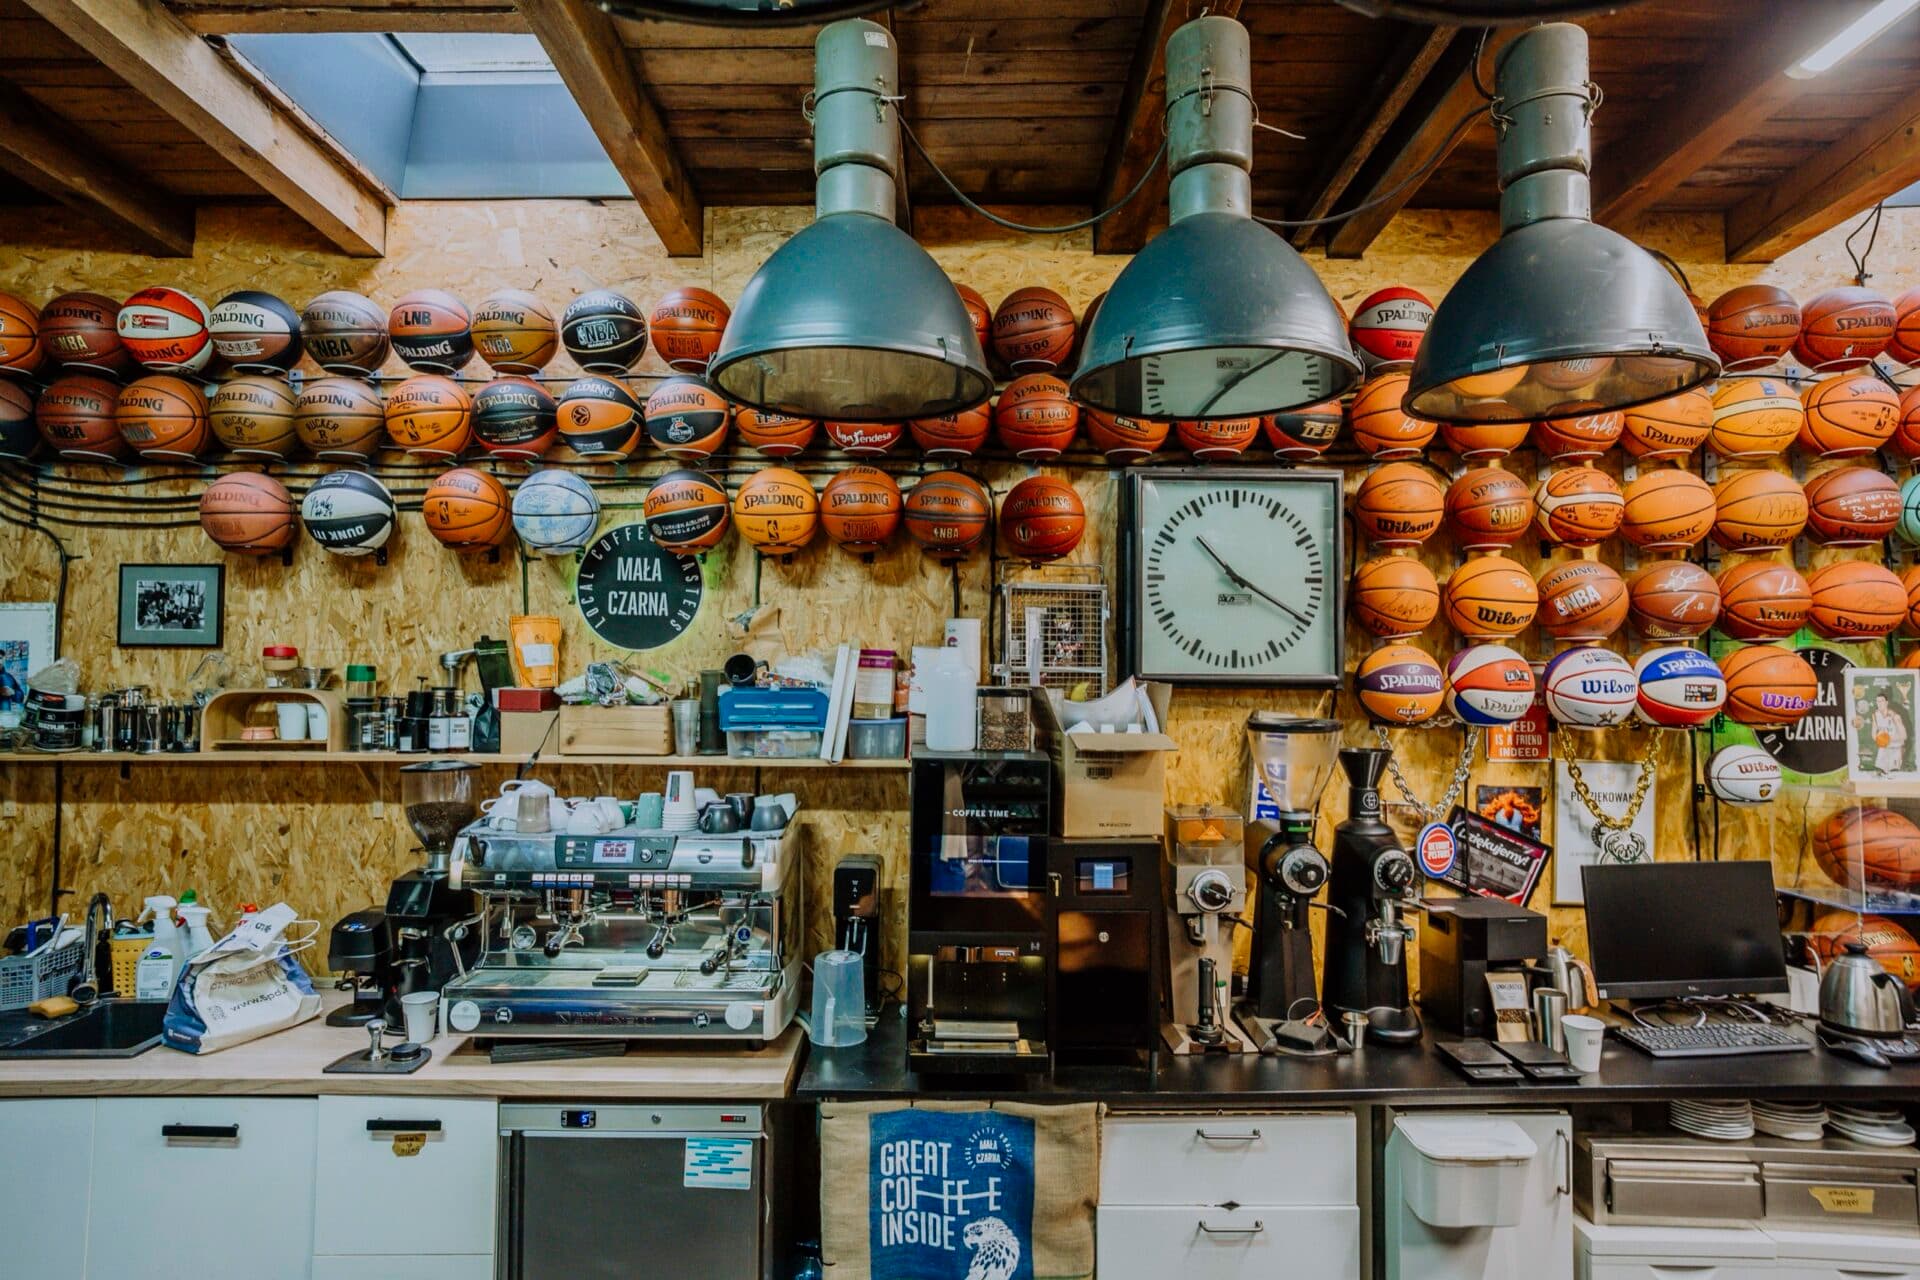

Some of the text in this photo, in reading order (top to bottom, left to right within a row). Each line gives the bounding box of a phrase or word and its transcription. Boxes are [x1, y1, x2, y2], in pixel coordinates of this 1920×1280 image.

[404, 311, 432, 326] LNB
[656, 307, 716, 324] SPALDING
[1744, 313, 1799, 329] SPALDIN
[1836, 315, 1895, 332] SPALDIN
[394, 340, 455, 358] SPALDING
[119, 398, 164, 412] ALDING
[477, 393, 540, 411] SPALDING
[648, 489, 704, 513] SPALDING
[744, 494, 804, 510] SPALDING
[832, 493, 889, 508] SPALDING
[919, 495, 969, 508] SPALDING
[330, 524, 366, 541] DUNK
[1376, 517, 1434, 534] Wilson
[617, 557, 662, 582] MAŁA
[608, 591, 669, 616] CZARNA
[1478, 606, 1532, 625] Wilson
[1380, 674, 1441, 690] SPALDING
[1582, 679, 1636, 695] Wilson
[1762, 692, 1815, 710] Wilso
[1495, 734, 1543, 746] IS A FRIEND
[1499, 748, 1539, 757] INDEED
[1738, 763, 1779, 775] Wilson
[988, 809, 1009, 817] TIME
[880, 1139, 952, 1178] GREAT
[881, 1176, 1002, 1215] COFFEE
[881, 1211, 956, 1250] INSIDE
